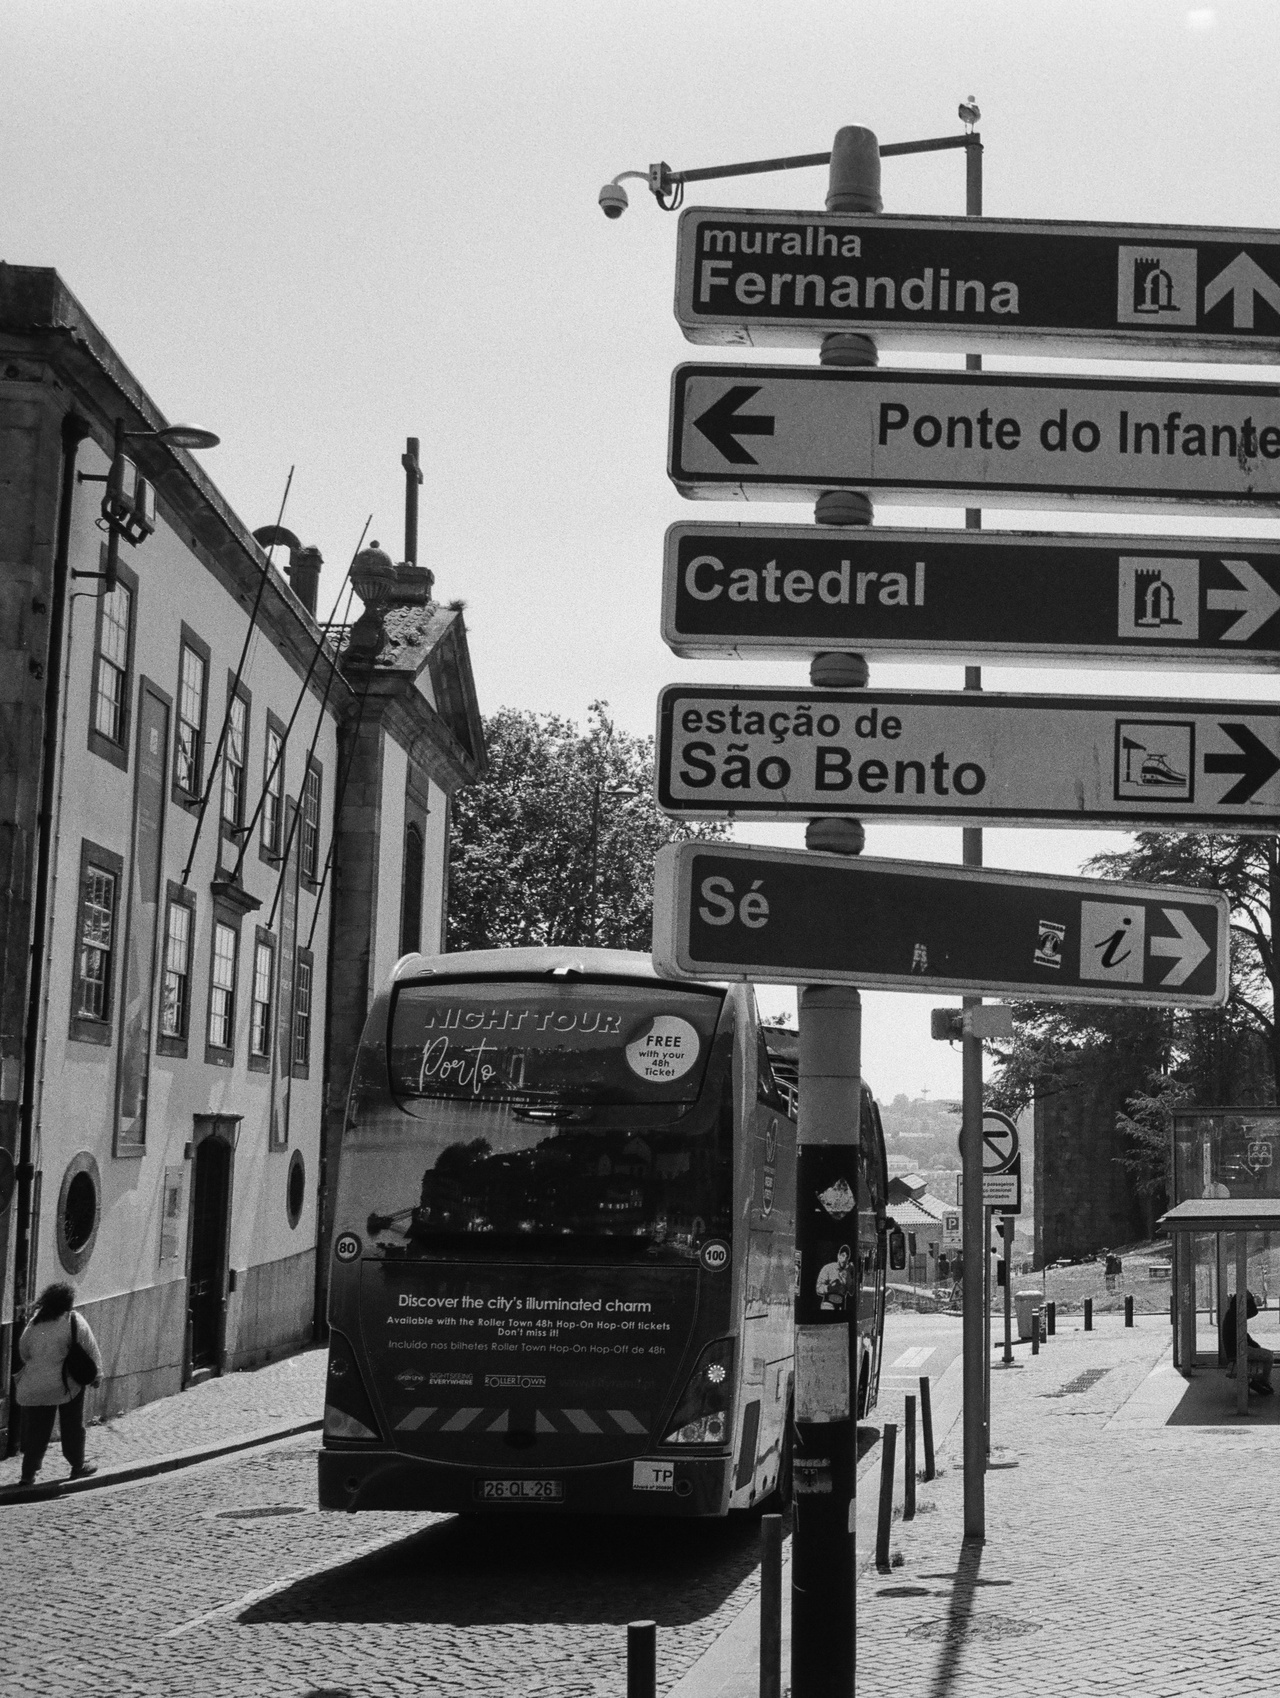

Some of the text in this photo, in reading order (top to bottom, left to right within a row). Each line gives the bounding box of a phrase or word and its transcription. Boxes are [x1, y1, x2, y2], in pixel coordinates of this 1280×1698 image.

[703, 226, 862, 257] muralha
[698, 260, 1020, 315] Fernandina
[878, 402, 1021, 451] Ponte
[1039, 408, 1101, 453] do
[684, 555, 926, 606] Catedral
[681, 705, 903, 744] estação de
[680, 742, 987, 797] São Bento
[699, 876, 770, 929] Sé
[424, 1008, 622, 1034] NIGHT TOUR
[646, 1035, 682, 1048] FREE
[638, 1050, 685, 1060] with your
[419, 1036, 498, 1095] Porto
[651, 1059, 670, 1068] 48h
[644, 1067, 675, 1078] Ticket
[340, 1242, 356, 1254] 80
[706, 1250, 725, 1261] 100
[398, 1294, 652, 1312] Discover the city's illuminated charm
[386, 1316, 671, 1331] Available with the Roller Town 48h Hop-On Hop-Off tickets
[498, 1328, 560, 1337] Don't miss it!
[430, 1342, 448, 1350] nos
[450, 1341, 489, 1351] bilhetes
[491, 1342, 518, 1352] Roller
[521, 1343, 546, 1352] Town
[549, 1344, 587, 1354] Hop-On
[590, 1344, 629, 1354] Hop-Off
[631, 1345, 645, 1354] de
[648, 1346, 666, 1354] 48h
[652, 1469, 673, 1482] TP
